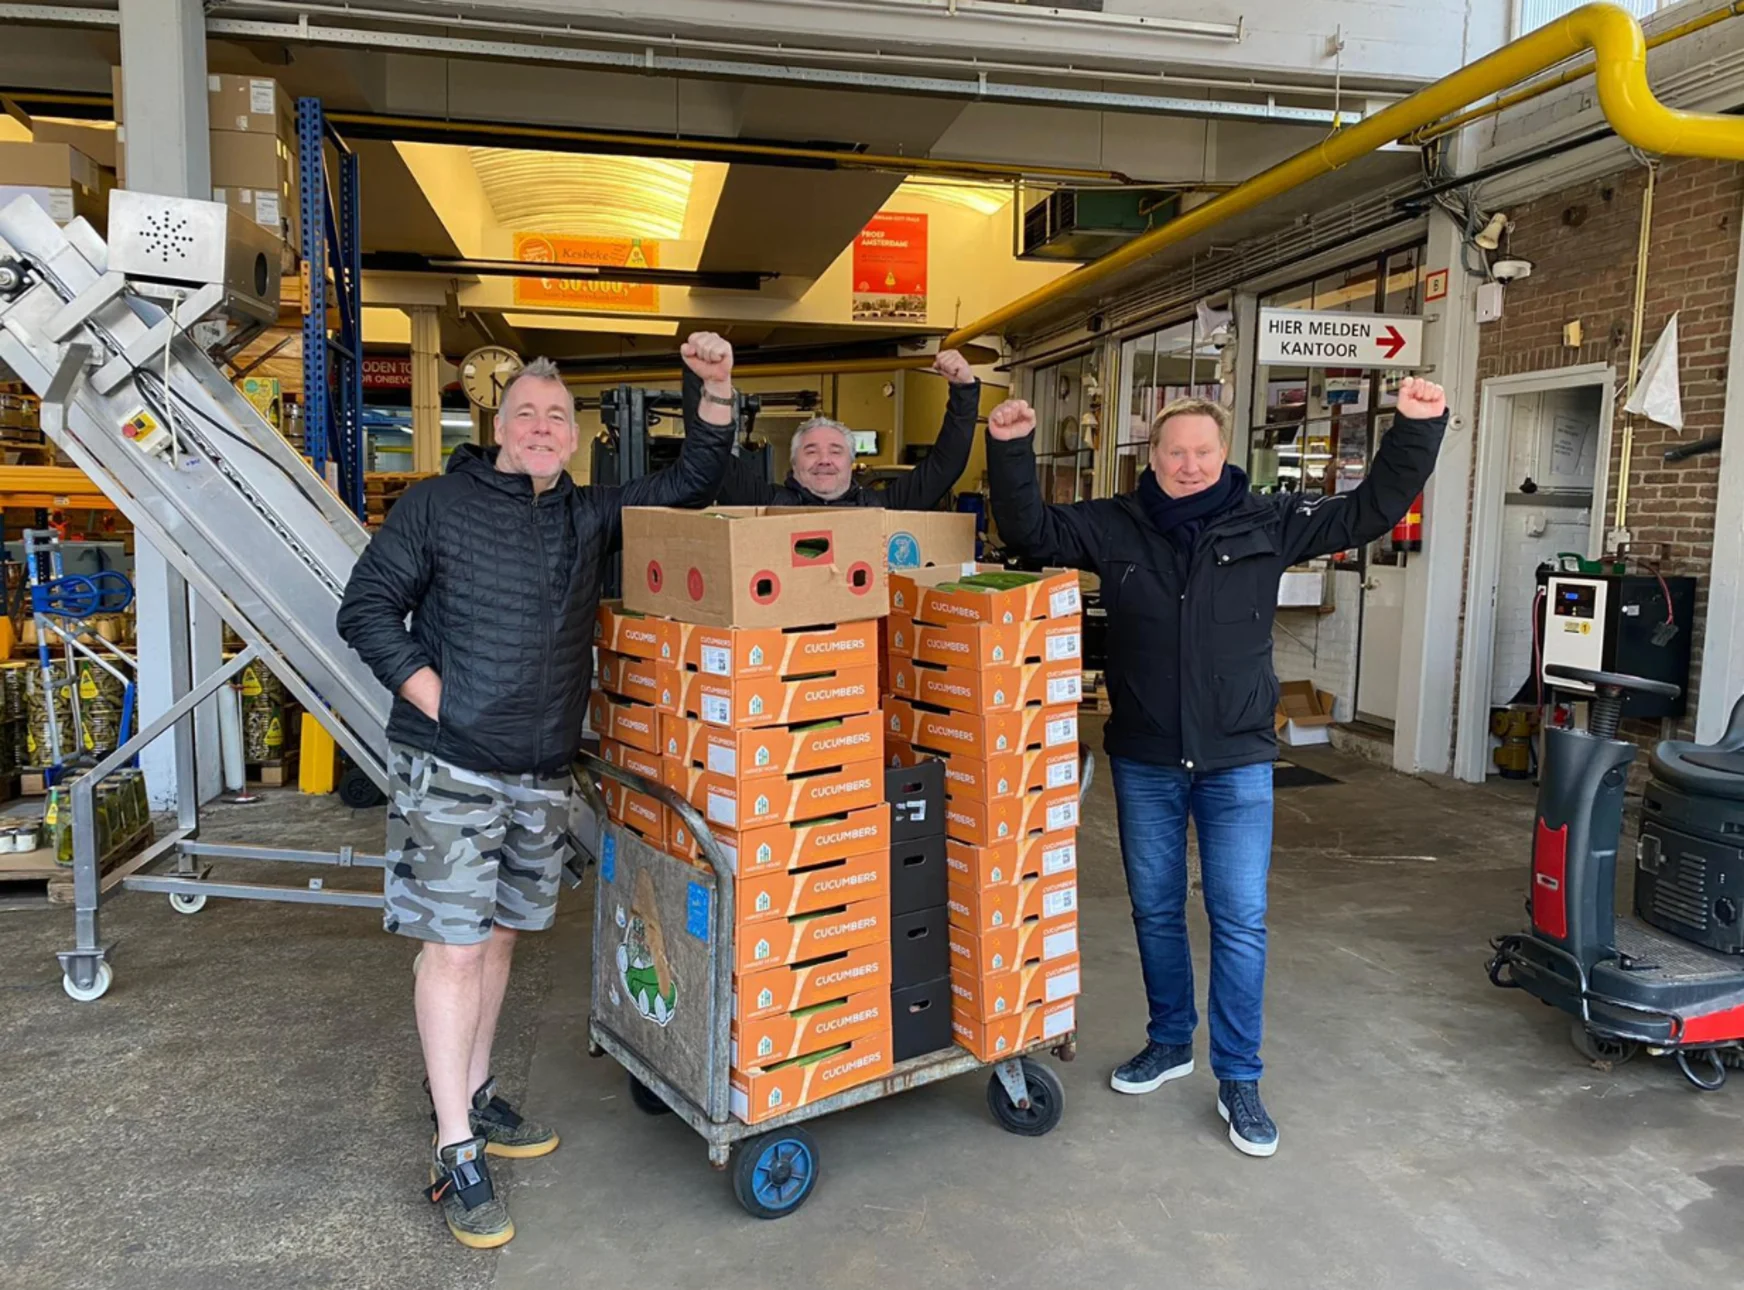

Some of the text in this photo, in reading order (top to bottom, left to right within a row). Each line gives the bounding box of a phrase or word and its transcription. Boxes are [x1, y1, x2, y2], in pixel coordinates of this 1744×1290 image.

[562, 248, 608, 260] Kesbeke
[1269, 320, 1371, 337] HIER MELDEN
[1280, 342, 1358, 358] KANTOOR
[362, 362, 396, 374] ODEN
[374, 375, 412, 384] ONBEVO
[931, 601, 980, 620] CUCUMBERS
[804, 638, 865, 654] CUCUMBERS
[927, 639, 970, 653] CUCUMBERS
[805, 684, 865, 702] CUCUMBERS
[928, 681, 972, 697] CUCUMBERS
[812, 732, 872, 751] CUCUMBERS
[928, 724, 974, 742] CUCUMBERS
[810, 778, 872, 798] CUCUMBERS
[816, 825, 878, 846] CUCUMBERS
[814, 871, 878, 892] CUCUMBERS
[813, 916, 877, 940] CUCUMBERS
[816, 962, 880, 987] CUCUMBERS
[816, 1006, 879, 1034] CUCUMBERS
[822, 1051, 882, 1080] CUCUMBERS
